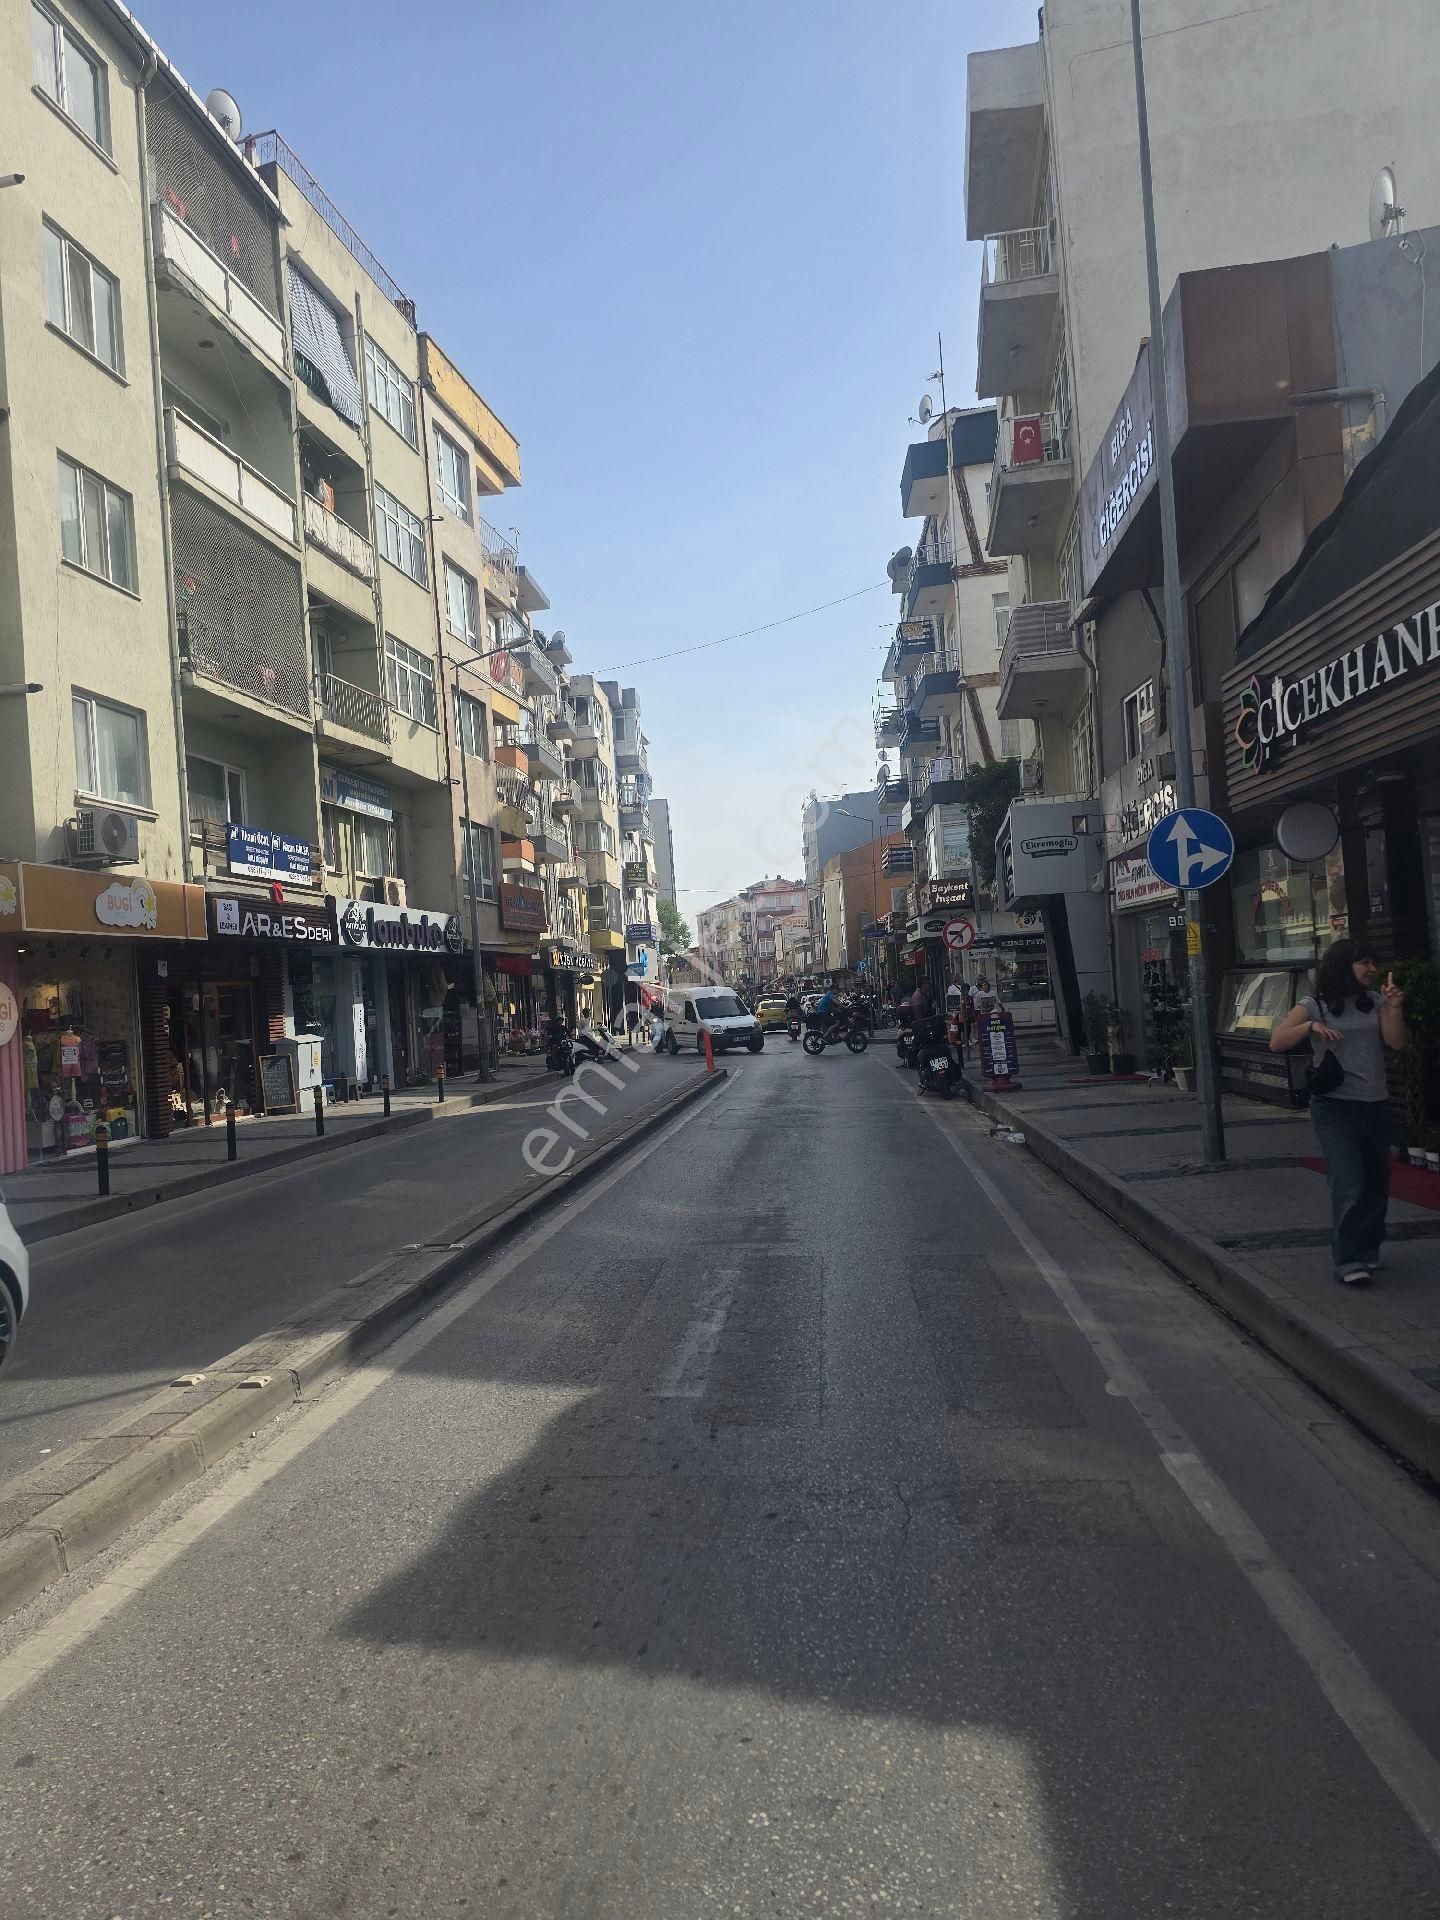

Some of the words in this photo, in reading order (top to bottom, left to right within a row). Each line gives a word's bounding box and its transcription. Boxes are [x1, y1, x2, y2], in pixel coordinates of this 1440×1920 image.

[1110, 405, 1134, 467] BİGA
[1099, 420, 1154, 548] CİĞERCİSİ
[931, 881, 969, 894] Baykent
